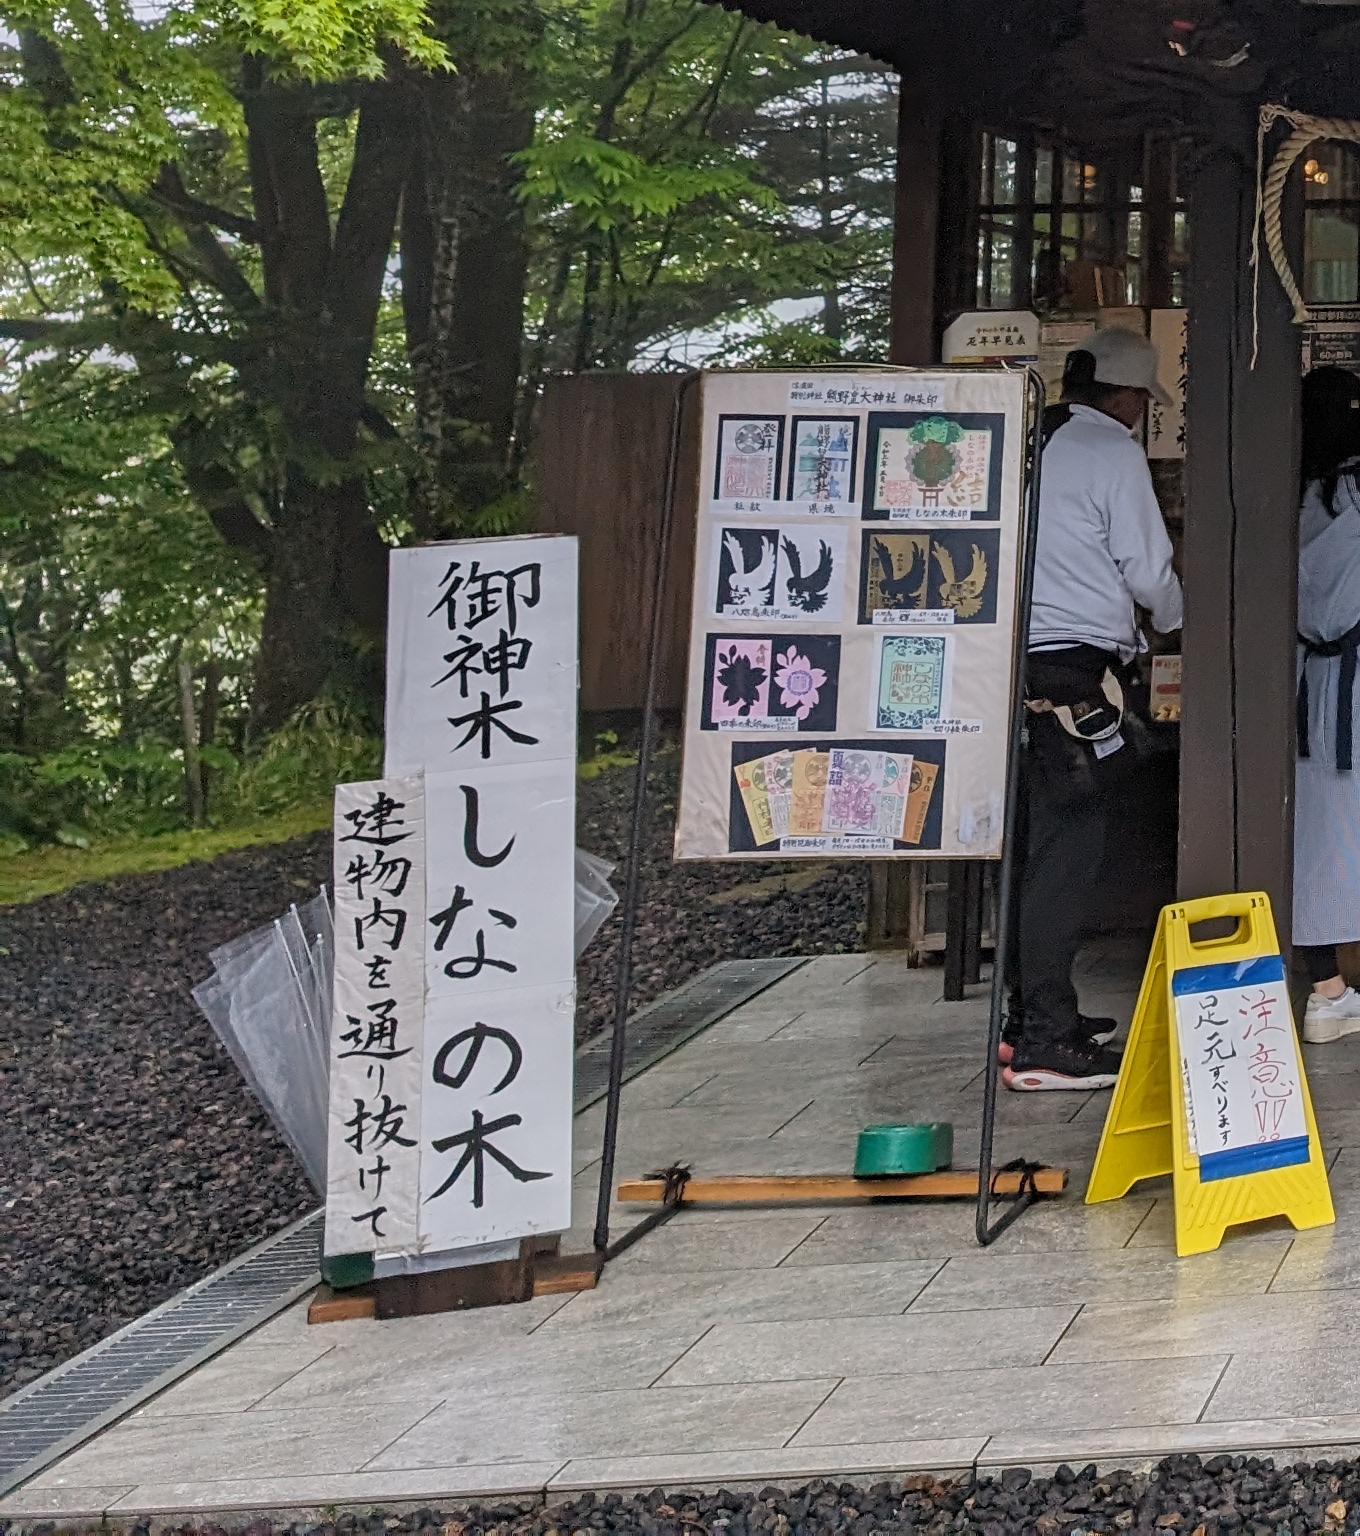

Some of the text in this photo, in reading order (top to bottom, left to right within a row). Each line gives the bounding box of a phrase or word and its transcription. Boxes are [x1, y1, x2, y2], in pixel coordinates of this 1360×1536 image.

[337, 791, 418, 1239] 建物内を通り抜けて
[424, 560, 554, 1209] 御神木しなの木
[1193, 994, 1237, 1147] 足元すべります
